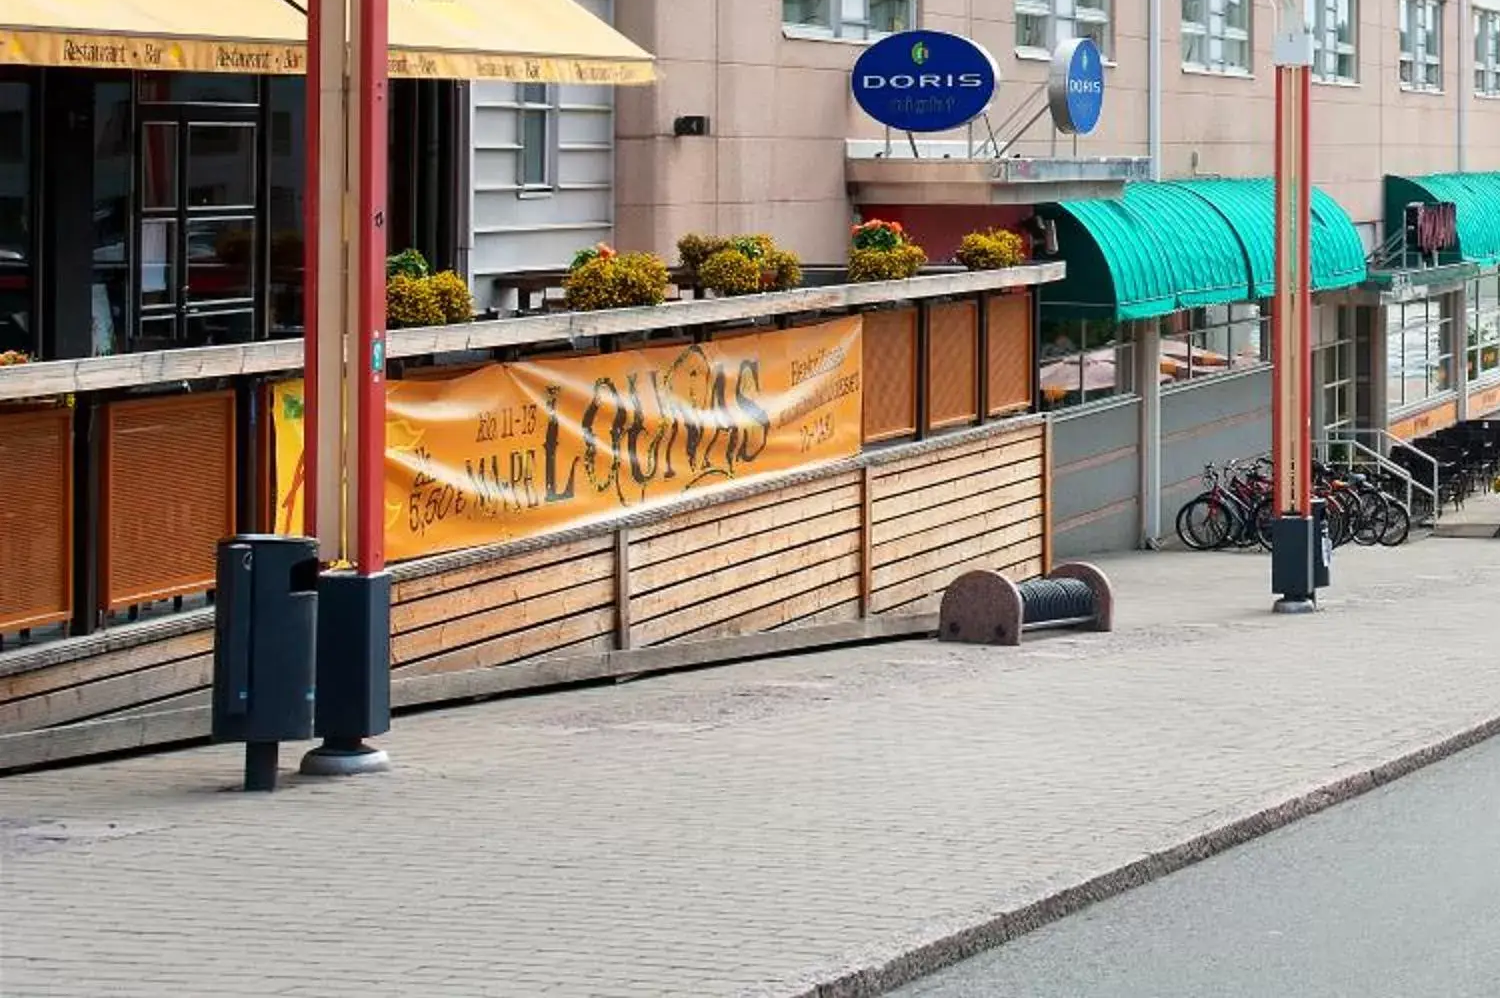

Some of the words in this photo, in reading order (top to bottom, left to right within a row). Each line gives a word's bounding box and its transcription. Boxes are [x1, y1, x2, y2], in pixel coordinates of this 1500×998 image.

[862, 72, 983, 90] DORIS
[1069, 79, 1101, 94] DORIS
[544, 351, 770, 504] LOUNAS
